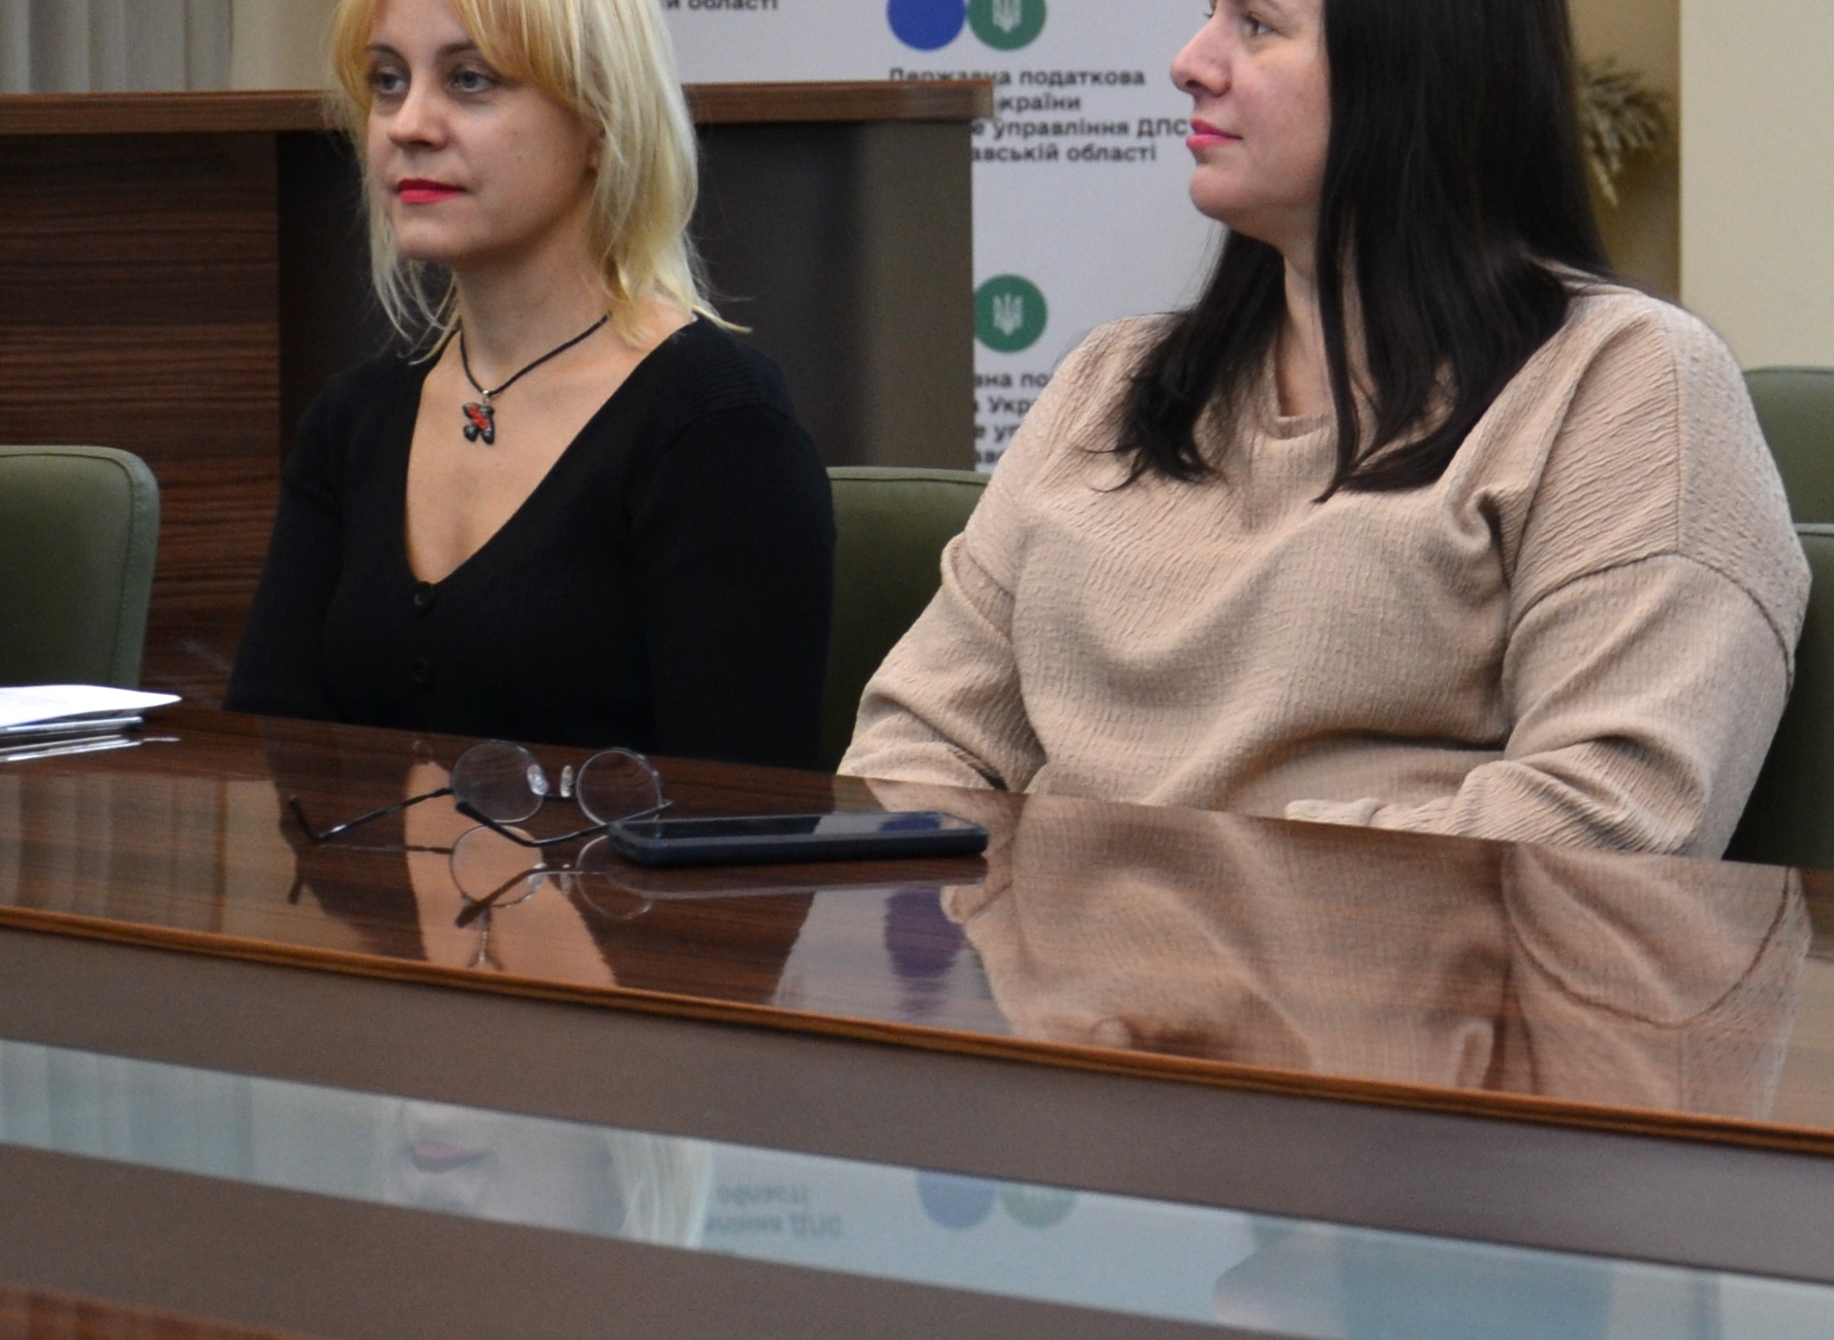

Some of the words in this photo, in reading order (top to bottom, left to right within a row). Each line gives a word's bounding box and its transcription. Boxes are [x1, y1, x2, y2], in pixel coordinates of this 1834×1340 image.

[1019, 71, 1145, 89] податкова
[998, 91, 1081, 113] країни
[992, 118, 1129, 140] управління
[1136, 119, 1187, 139] ДПС
[1065, 142, 1155, 162] області
